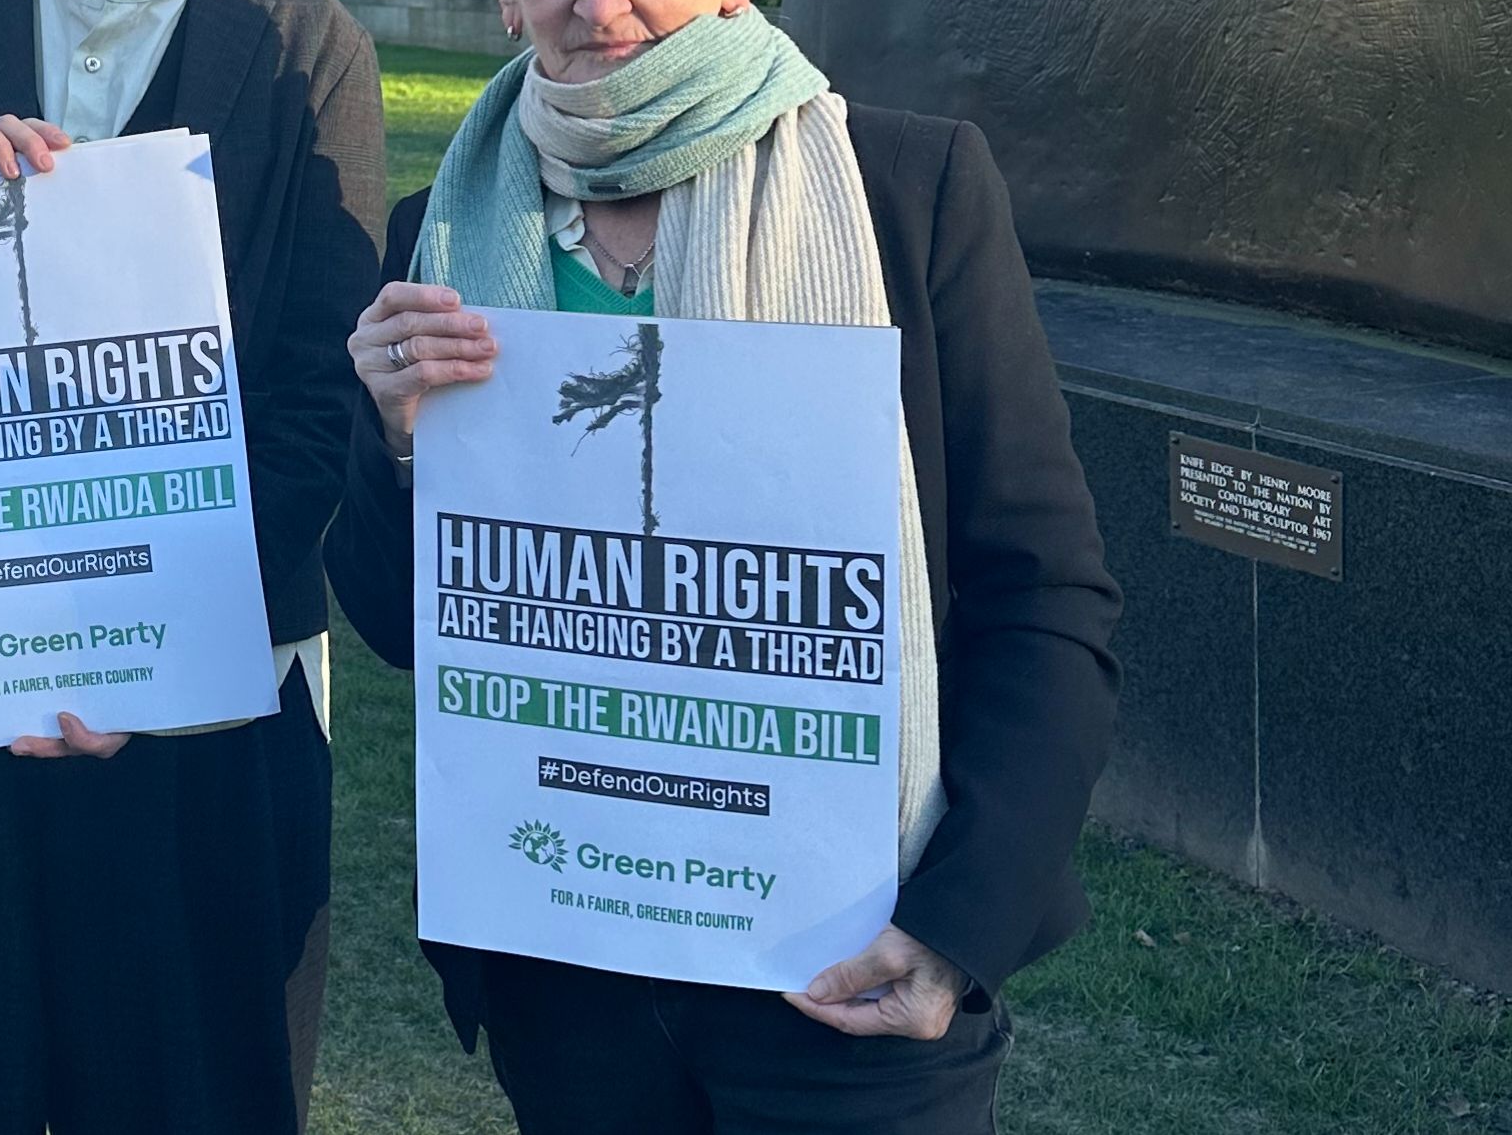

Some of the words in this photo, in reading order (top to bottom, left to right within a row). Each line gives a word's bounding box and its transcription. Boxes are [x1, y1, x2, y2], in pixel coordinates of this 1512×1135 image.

[44, 332, 221, 407] RIGHTS
[50, 418, 86, 452] BY
[94, 416, 113, 448] A
[121, 404, 230, 446] THREAD
[22, 476, 156, 528] RWANDA
[165, 468, 232, 510] BILL
[1180, 454, 1204, 469] KNIFE
[1211, 462, 1234, 477] EDGE
[1241, 470, 1253, 481] BY
[1260, 474, 1291, 492] HENRY
[1298, 485, 1331, 502] MOORE
[1180, 467, 1227, 487] PRESENTED
[1233, 480, 1246, 492] TO
[1252, 485, 1271, 498] THE
[1277, 492, 1313, 510] NATION
[1320, 503, 1332, 514] BY
[1180, 479, 1197, 492] THE
[1218, 489, 1291, 517] CONTEMPORARY
[1313, 516, 1332, 528] ART
[1180, 492, 1216, 509] SOCIETY
[1219, 502, 1239, 515] AND
[1242, 508, 1260, 522] THE
[1264, 515, 1309, 536] SCULPTOR
[1313, 528, 1332, 541] 1967
[440, 518, 642, 608] HUMAN
[664, 544, 881, 630] RIGHTS
[90, 621, 166, 651] Party
[440, 598, 499, 641] ARE
[510, 611, 650, 660] HANGING
[661, 626, 702, 664] BY
[713, 630, 736, 667] A
[745, 632, 882, 681] THREAD
[3, 680, 10, 694] A
[12, 676, 54, 694] FAIRER,
[56, 672, 103, 690] GREENER
[106, 667, 154, 685] COUNTRY
[443, 670, 529, 721] STOP
[541, 683, 607, 734] THE
[620, 693, 781, 752] RWANDA
[794, 711, 876, 762] BILL
[540, 761, 767, 809] #DefendOurRights
[578, 843, 675, 882] Green
[685, 859, 776, 899] Party
[551, 889, 573, 906] FOR
[576, 892, 585, 908] A
[588, 894, 633, 918] FAIRER,
[637, 903, 692, 924] GREENER
[695, 910, 754, 931] COUNTRY
